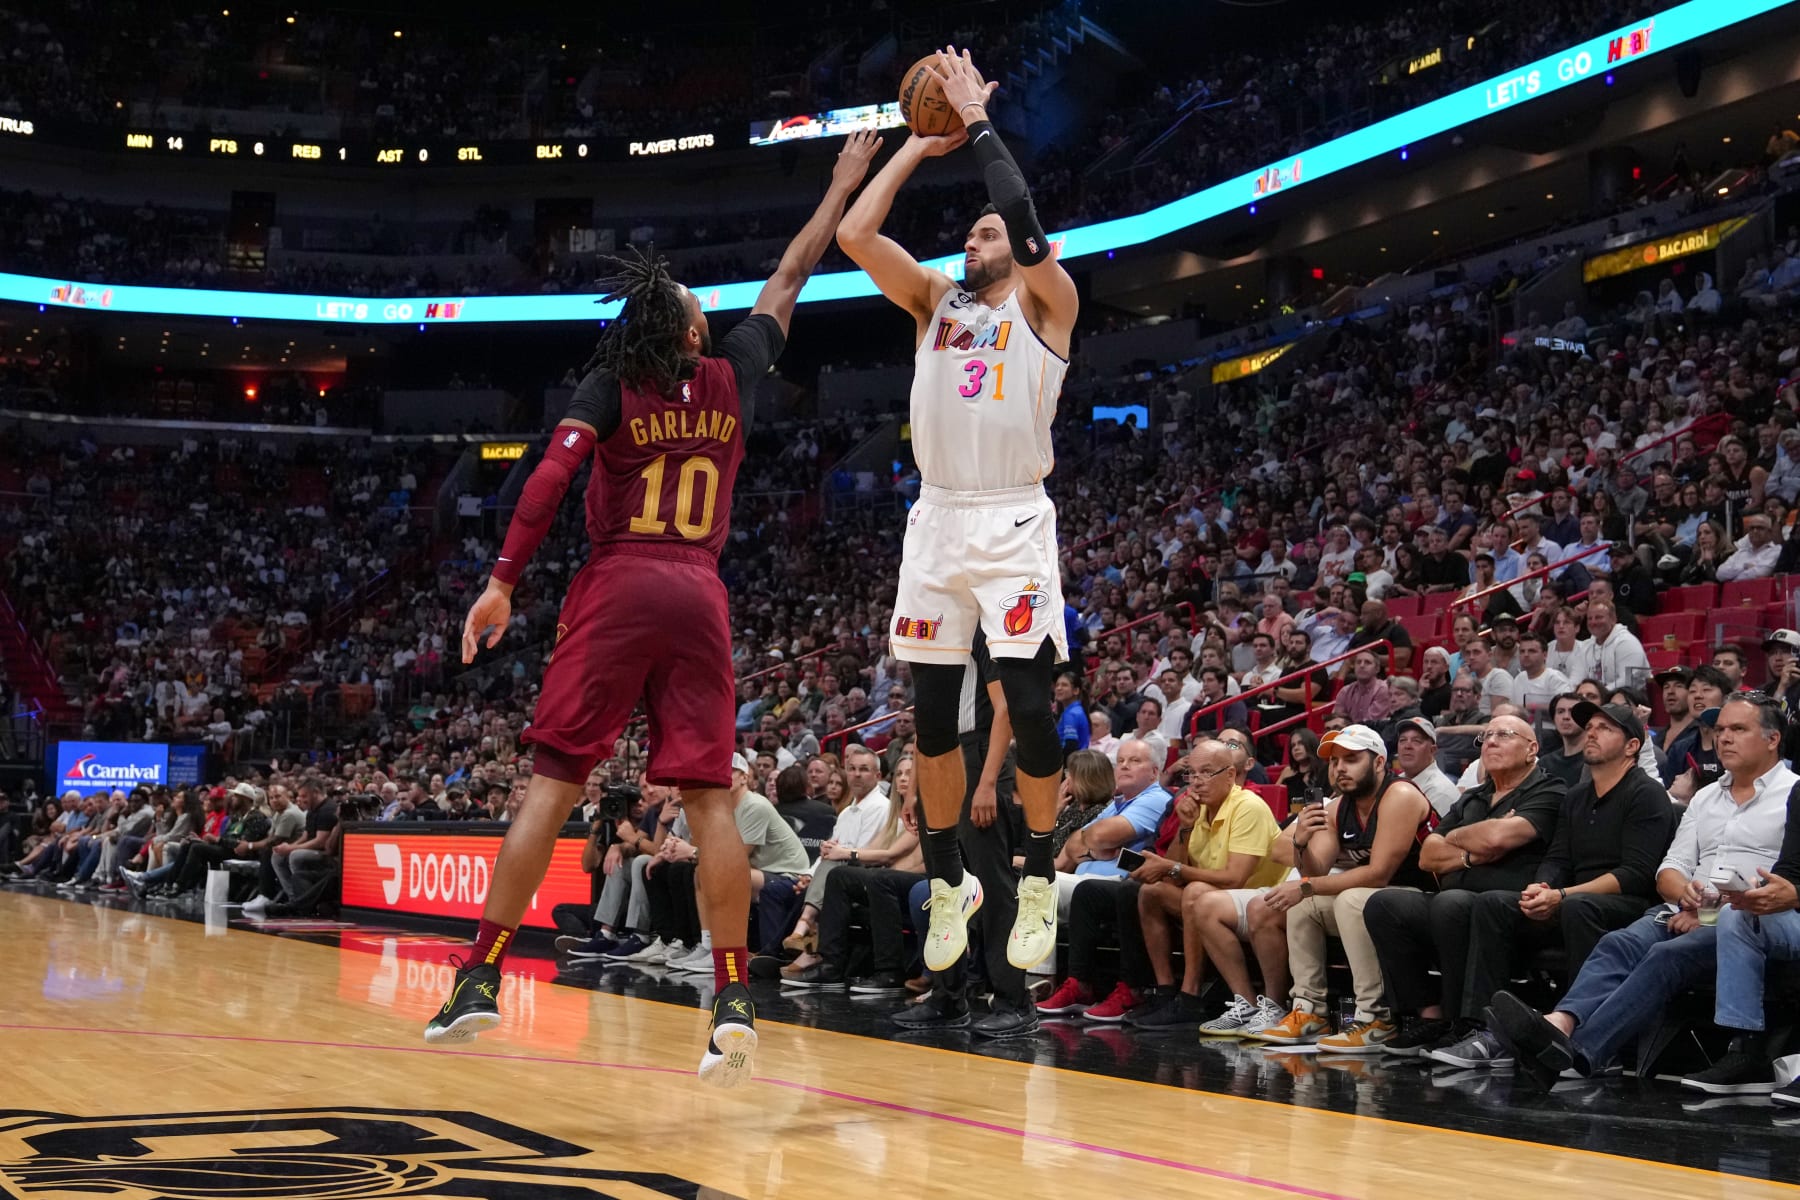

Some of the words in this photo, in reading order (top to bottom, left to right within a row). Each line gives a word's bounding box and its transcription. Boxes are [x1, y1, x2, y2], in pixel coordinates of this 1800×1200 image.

[1486, 70, 1540, 109] LET'S
[1558, 51, 1592, 82] GO
[127, 134, 153, 148] MIN
[167, 136, 183, 150] 14
[210, 139, 238, 153] PTS
[292, 144, 321, 158] REB
[338, 147, 346, 160] 1
[377, 149, 403, 163] AST
[418, 148, 428, 162] 0
[457, 147, 483, 161] STL
[536, 145, 562, 159] BLK
[578, 144, 588, 157] 0
[629, 138, 676, 156] PLAYER
[678, 133, 714, 150] STATS
[316, 301, 369, 320] LET'S
[383, 302, 414, 321] GO
[958, 359, 1006, 401] 31
[629, 410, 737, 446] GARLAND
[482, 443, 527, 459] BACARD
[629, 454, 720, 540] 10
[87, 763, 160, 780] Carnival
